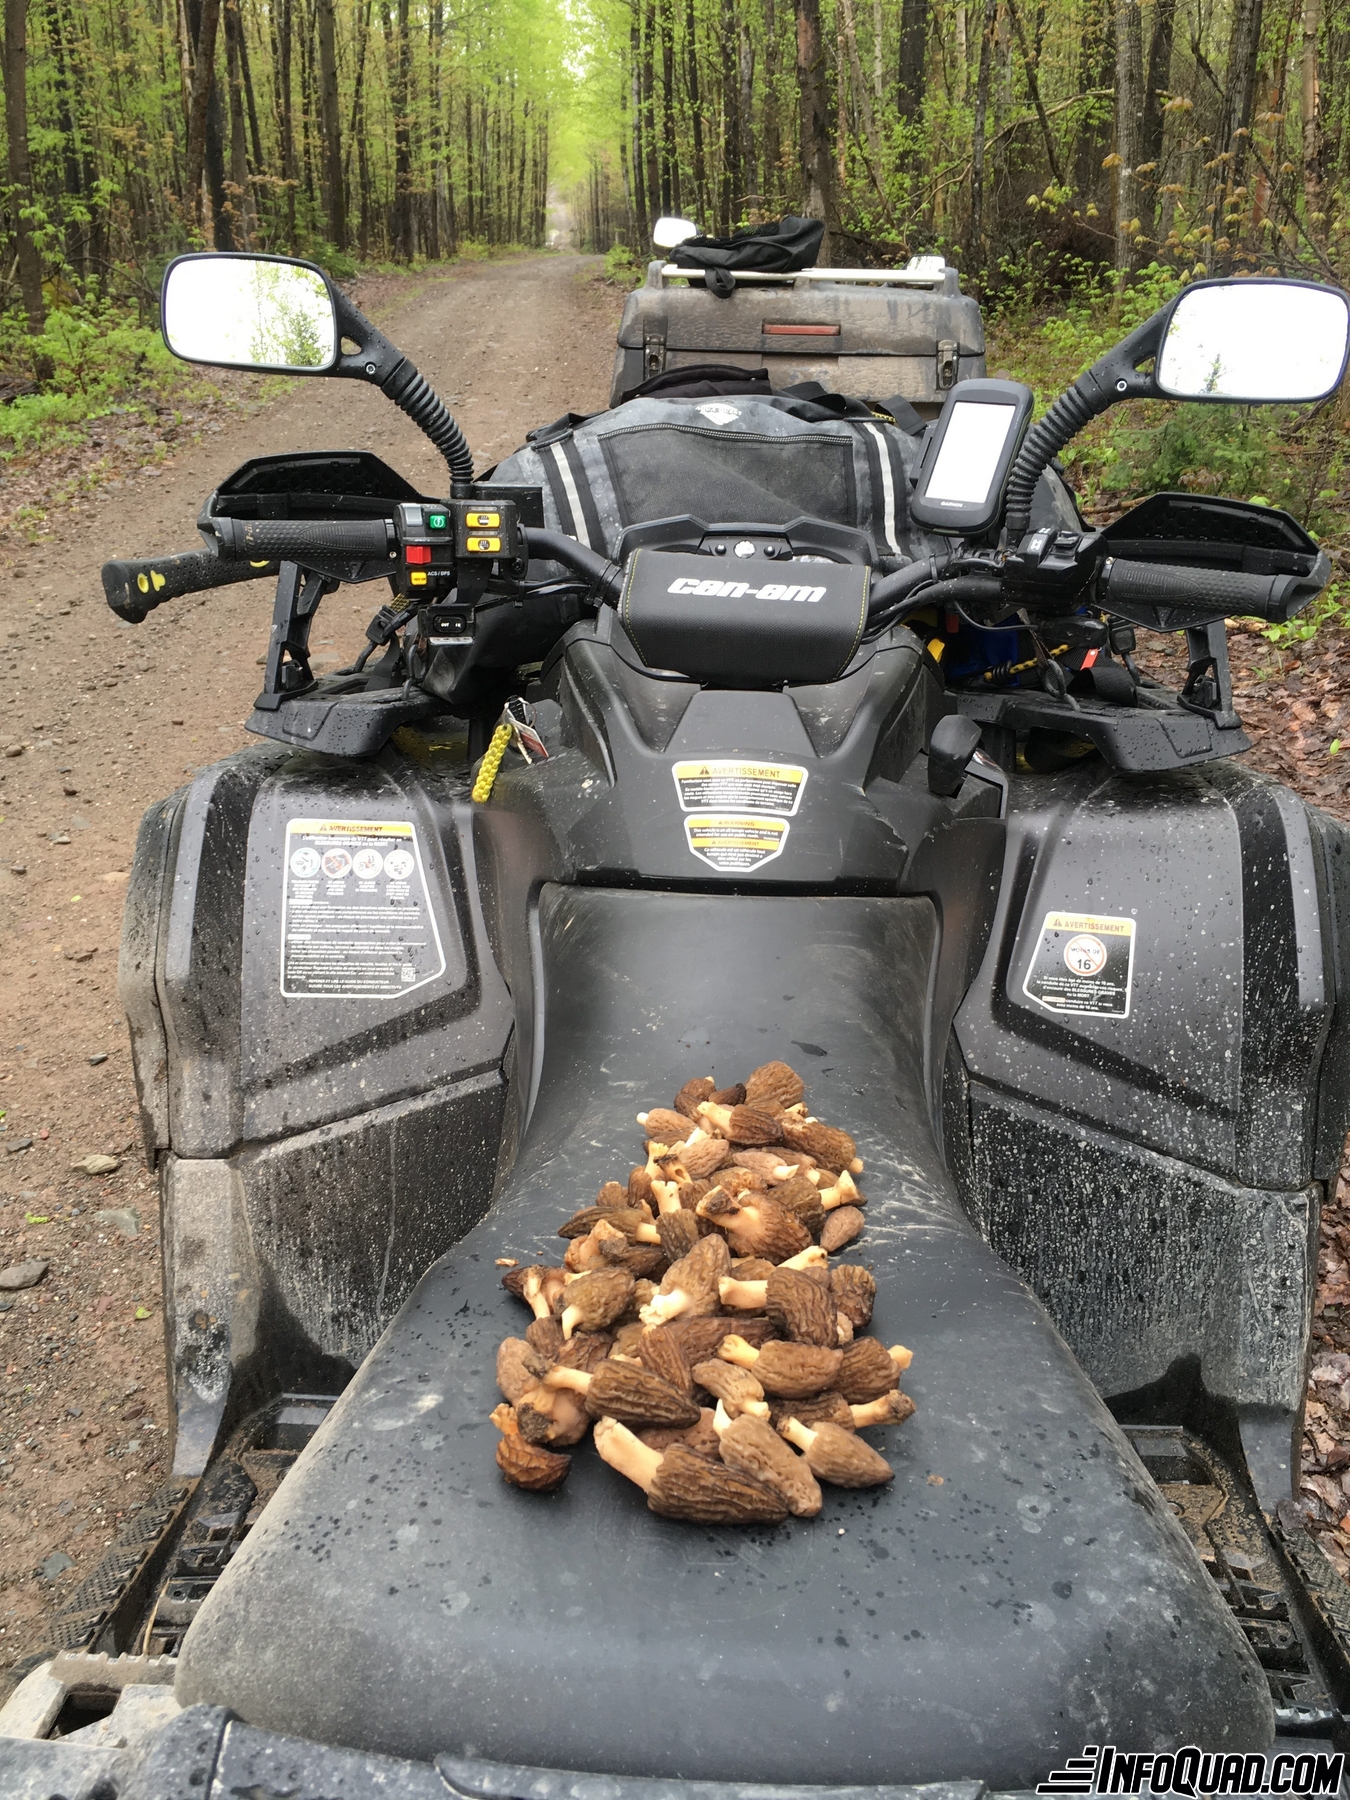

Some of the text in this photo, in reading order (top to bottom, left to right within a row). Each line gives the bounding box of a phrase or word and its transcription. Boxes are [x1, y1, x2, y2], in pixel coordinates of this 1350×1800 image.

[712, 767, 780, 778] AVERTISSEMENT
[1064, 921, 1125, 932] AVERTISSEMENT
[1077, 958, 1091, 970] 16
